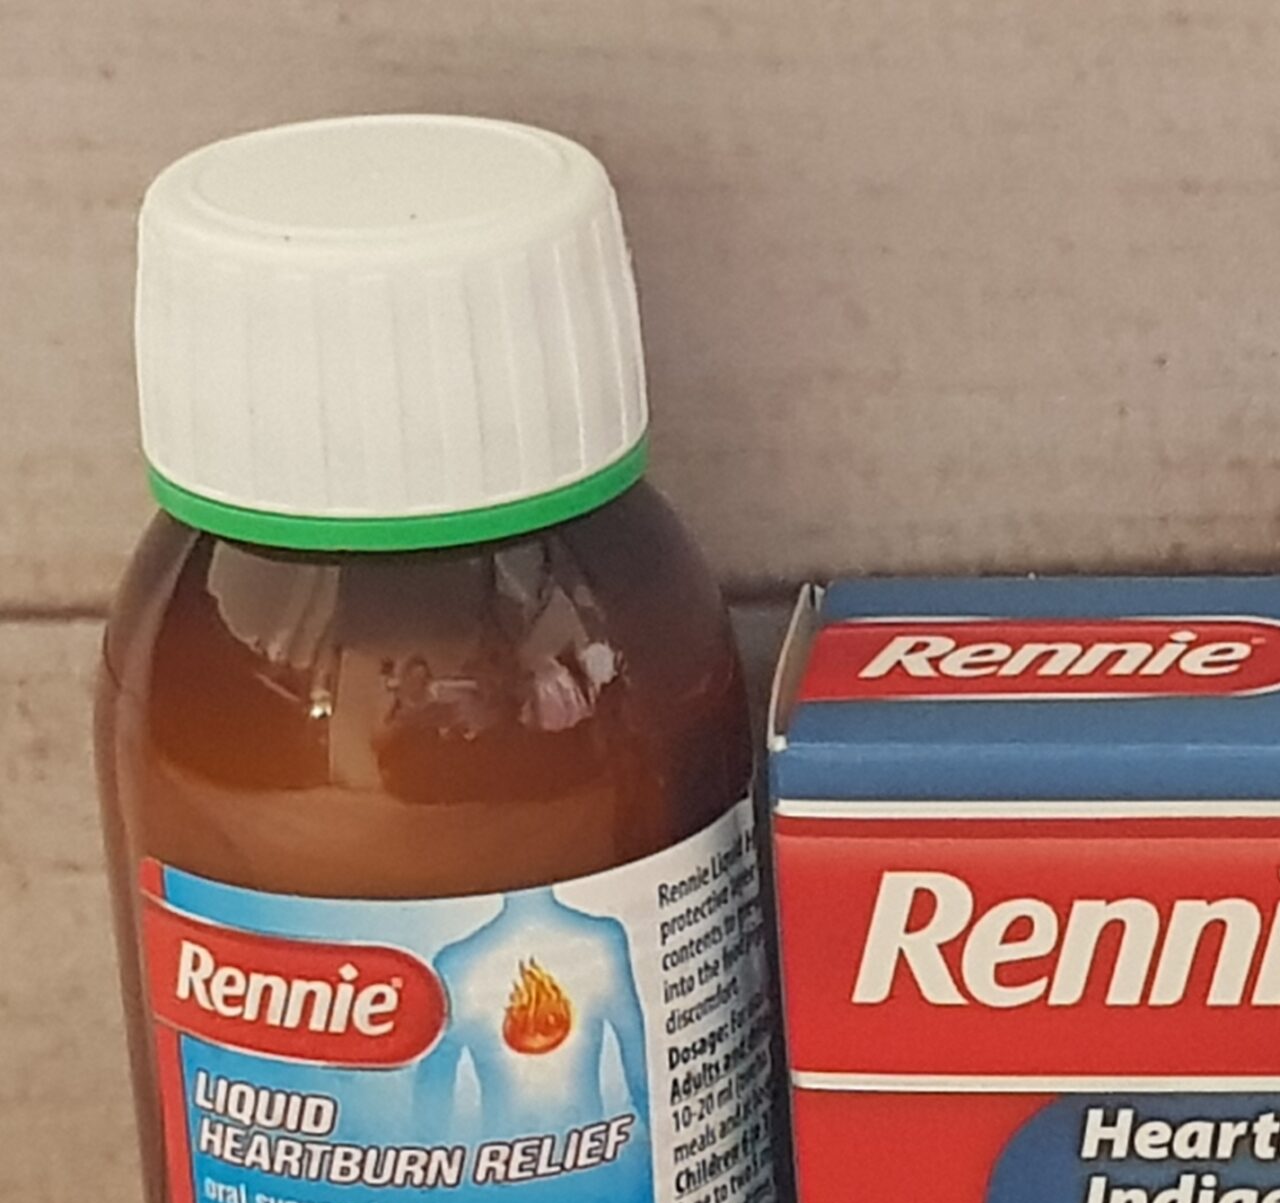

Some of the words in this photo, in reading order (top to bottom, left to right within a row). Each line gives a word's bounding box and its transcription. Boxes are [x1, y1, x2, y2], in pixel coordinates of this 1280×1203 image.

[858, 630, 1252, 679] Rennie
[176, 940, 399, 1036] Rennie
[194, 1070, 338, 1135] LIQUID
[670, 1060, 721, 1104] Adults
[200, 1118, 465, 1187] HEARTBURN
[474, 1114, 635, 1184] RELIEF
[674, 1123, 717, 1164] meals
